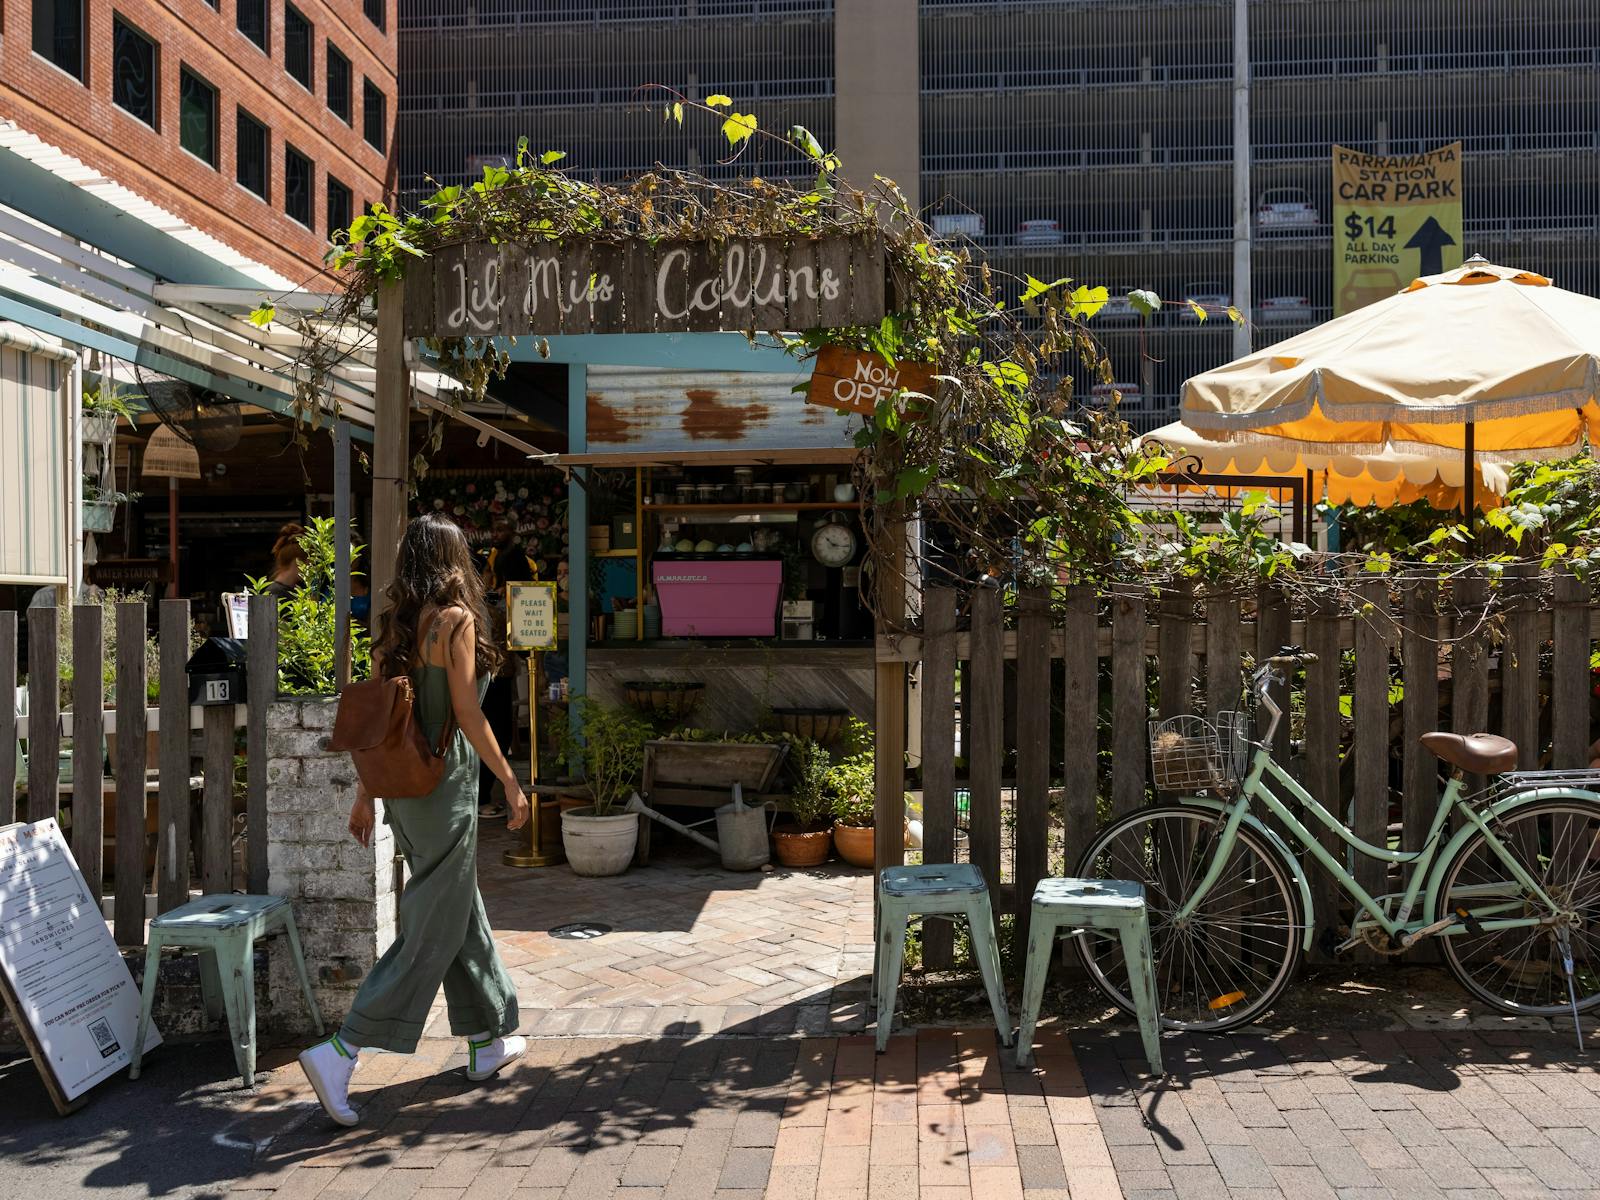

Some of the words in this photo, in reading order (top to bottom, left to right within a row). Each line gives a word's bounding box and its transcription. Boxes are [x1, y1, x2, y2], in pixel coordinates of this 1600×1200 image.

[1339, 151, 1456, 168] PARRAMATTA
[1359, 166, 1437, 182] STATION
[1339, 182, 1387, 201] CAR
[1395, 179, 1456, 201] PARK
[1344, 211, 1397, 241] $14
[1344, 253, 1400, 264] PARKING
[1346, 242, 1368, 253] ALL
[1373, 242, 1397, 253] DAY
[447, 258, 504, 331] Lil
[523, 255, 614, 316] Miss
[656, 243, 841, 319] Collins
[854, 359, 900, 387] NOW
[210, 682, 227, 699] 13
[31, 924, 74, 946] SANDWICHES
[44, 1019, 55, 1028] YOU
[54, 1013, 65, 1022] CAN
[64, 1007, 76, 1016] NOW
[85, 994, 101, 1006] ORDER
[109, 984, 121, 993] PICK
